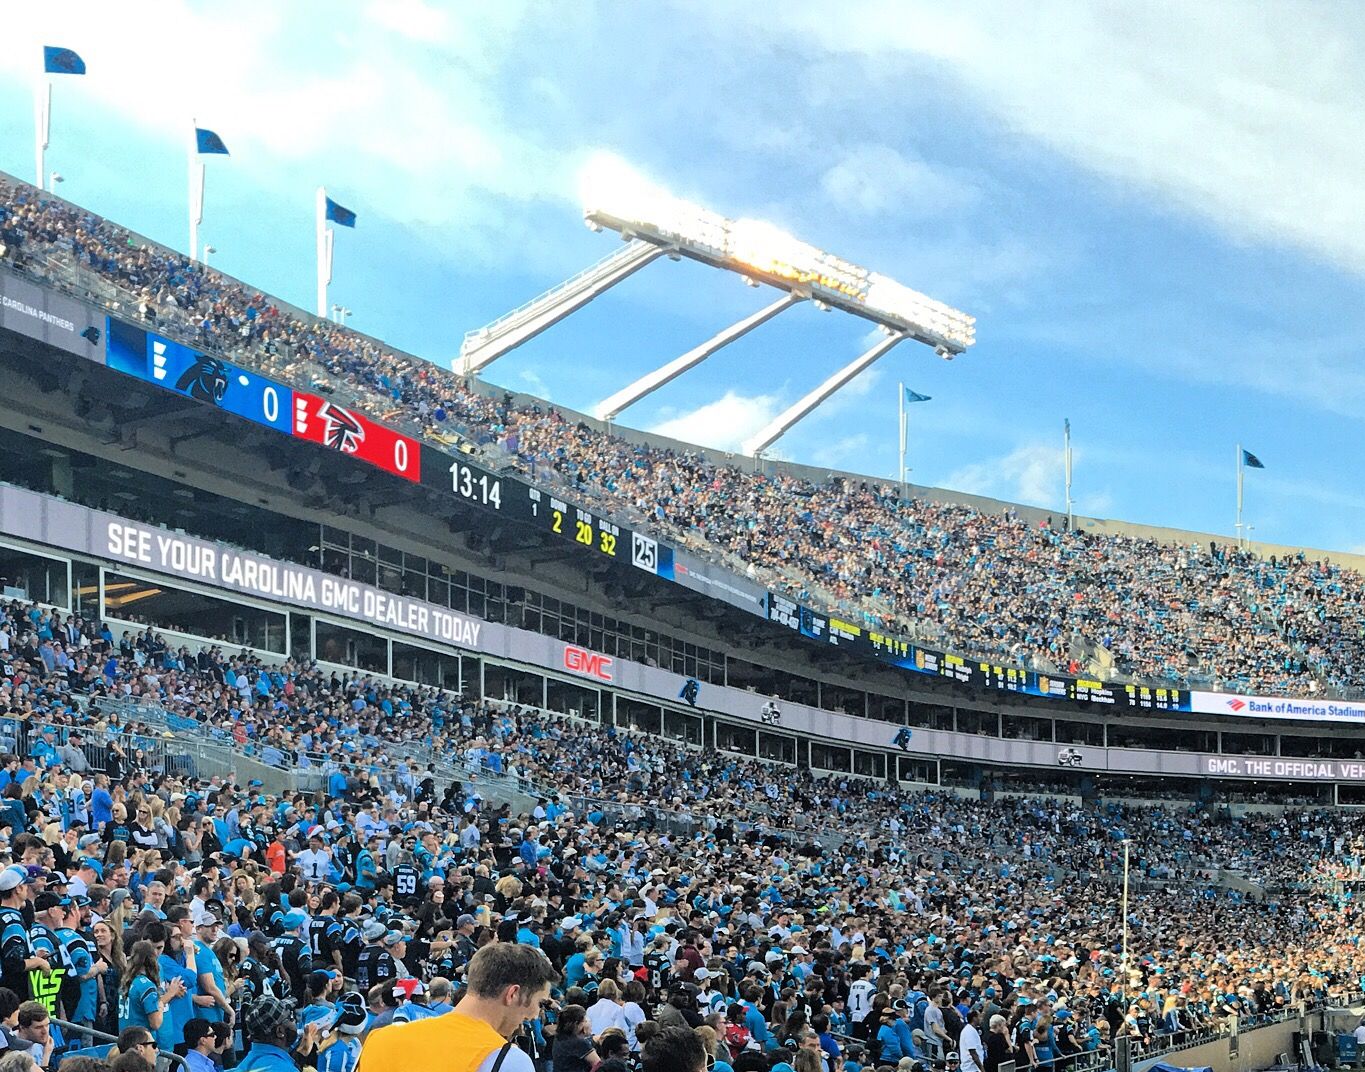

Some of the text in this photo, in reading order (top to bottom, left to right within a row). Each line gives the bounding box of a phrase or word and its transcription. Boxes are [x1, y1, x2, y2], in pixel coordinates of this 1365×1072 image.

[2, 296, 75, 332] CAROLINA PANTHERS
[263, 386, 278, 422] 0
[394, 439, 408, 472] 0
[449, 461, 502, 511] 13:14
[531, 503, 616, 557] 1 2 20 32
[635, 538, 655, 567] 25
[108, 522, 481, 646] SEE YOUR CAROLINA GMC DEALER TODAY
[564, 645, 613, 682] GMC
[1249, 701, 1365, 718] Bank of America Stadium
[1208, 758, 1241, 774] GMC.
[1245, 760, 1272, 775] THE
[1275, 761, 1335, 777] OFFICIAL
[396, 874, 416, 894] 59
[312, 933, 321, 955] 1
[29, 968, 66, 995] YES
